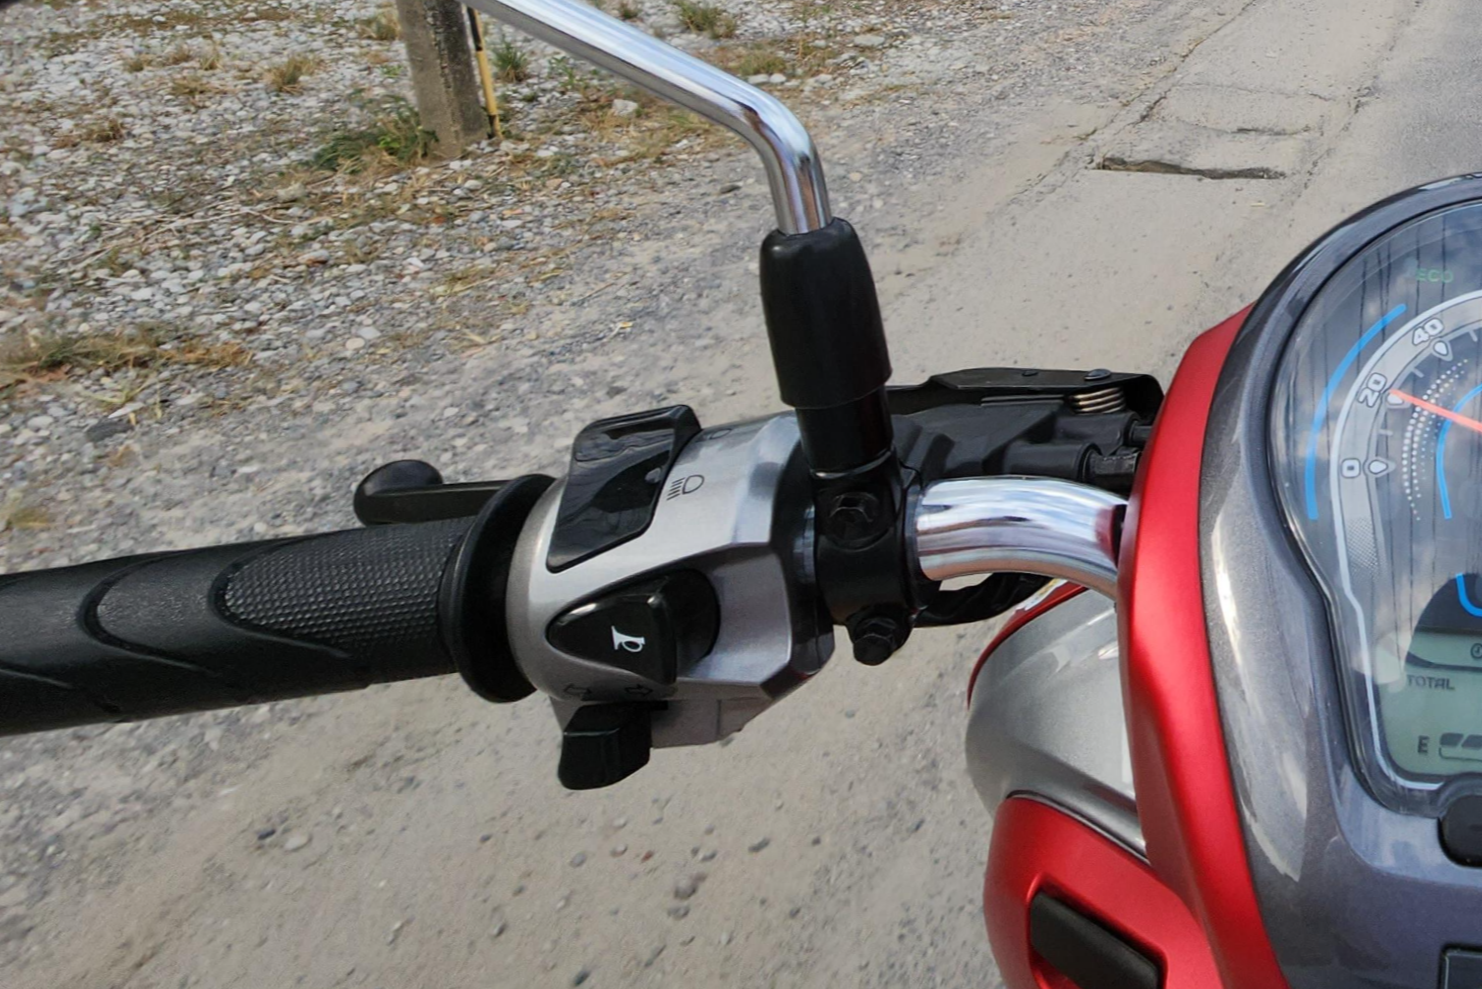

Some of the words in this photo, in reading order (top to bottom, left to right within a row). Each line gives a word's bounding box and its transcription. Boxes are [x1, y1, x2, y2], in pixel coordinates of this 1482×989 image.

[1415, 268, 1453, 284] ECO
[1412, 318, 1444, 346] 40
[1358, 372, 1387, 408] 20
[1341, 458, 1361, 478] 0
[1407, 674, 1455, 692] TOTAL
[1418, 735, 1430, 755] E
